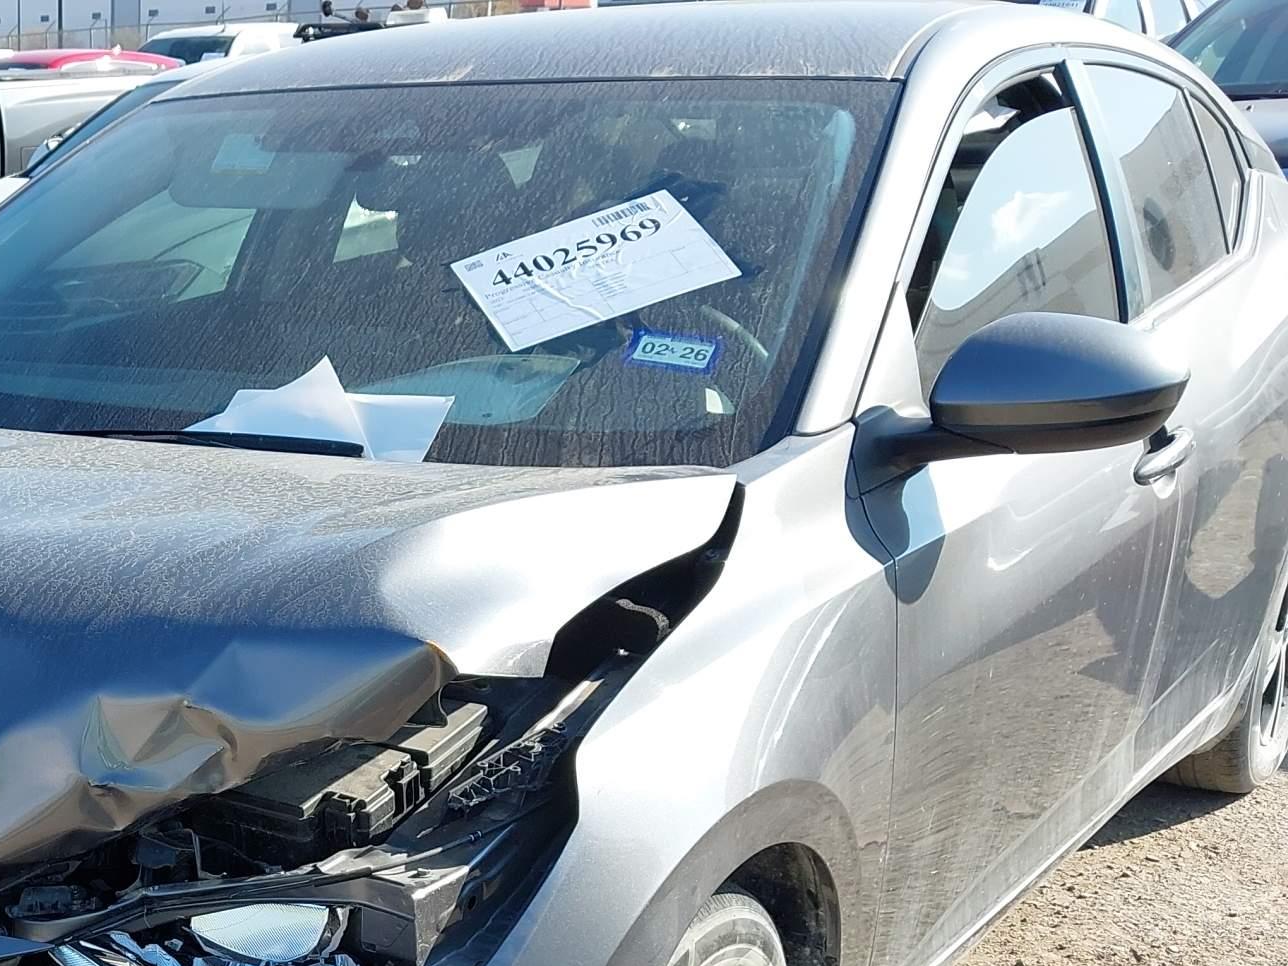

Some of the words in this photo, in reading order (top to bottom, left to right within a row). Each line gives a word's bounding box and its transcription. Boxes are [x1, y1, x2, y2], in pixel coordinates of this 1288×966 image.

[492, 218, 661, 286] 44025969
[641, 342, 670, 356] 02
[679, 346, 710, 362] 26
